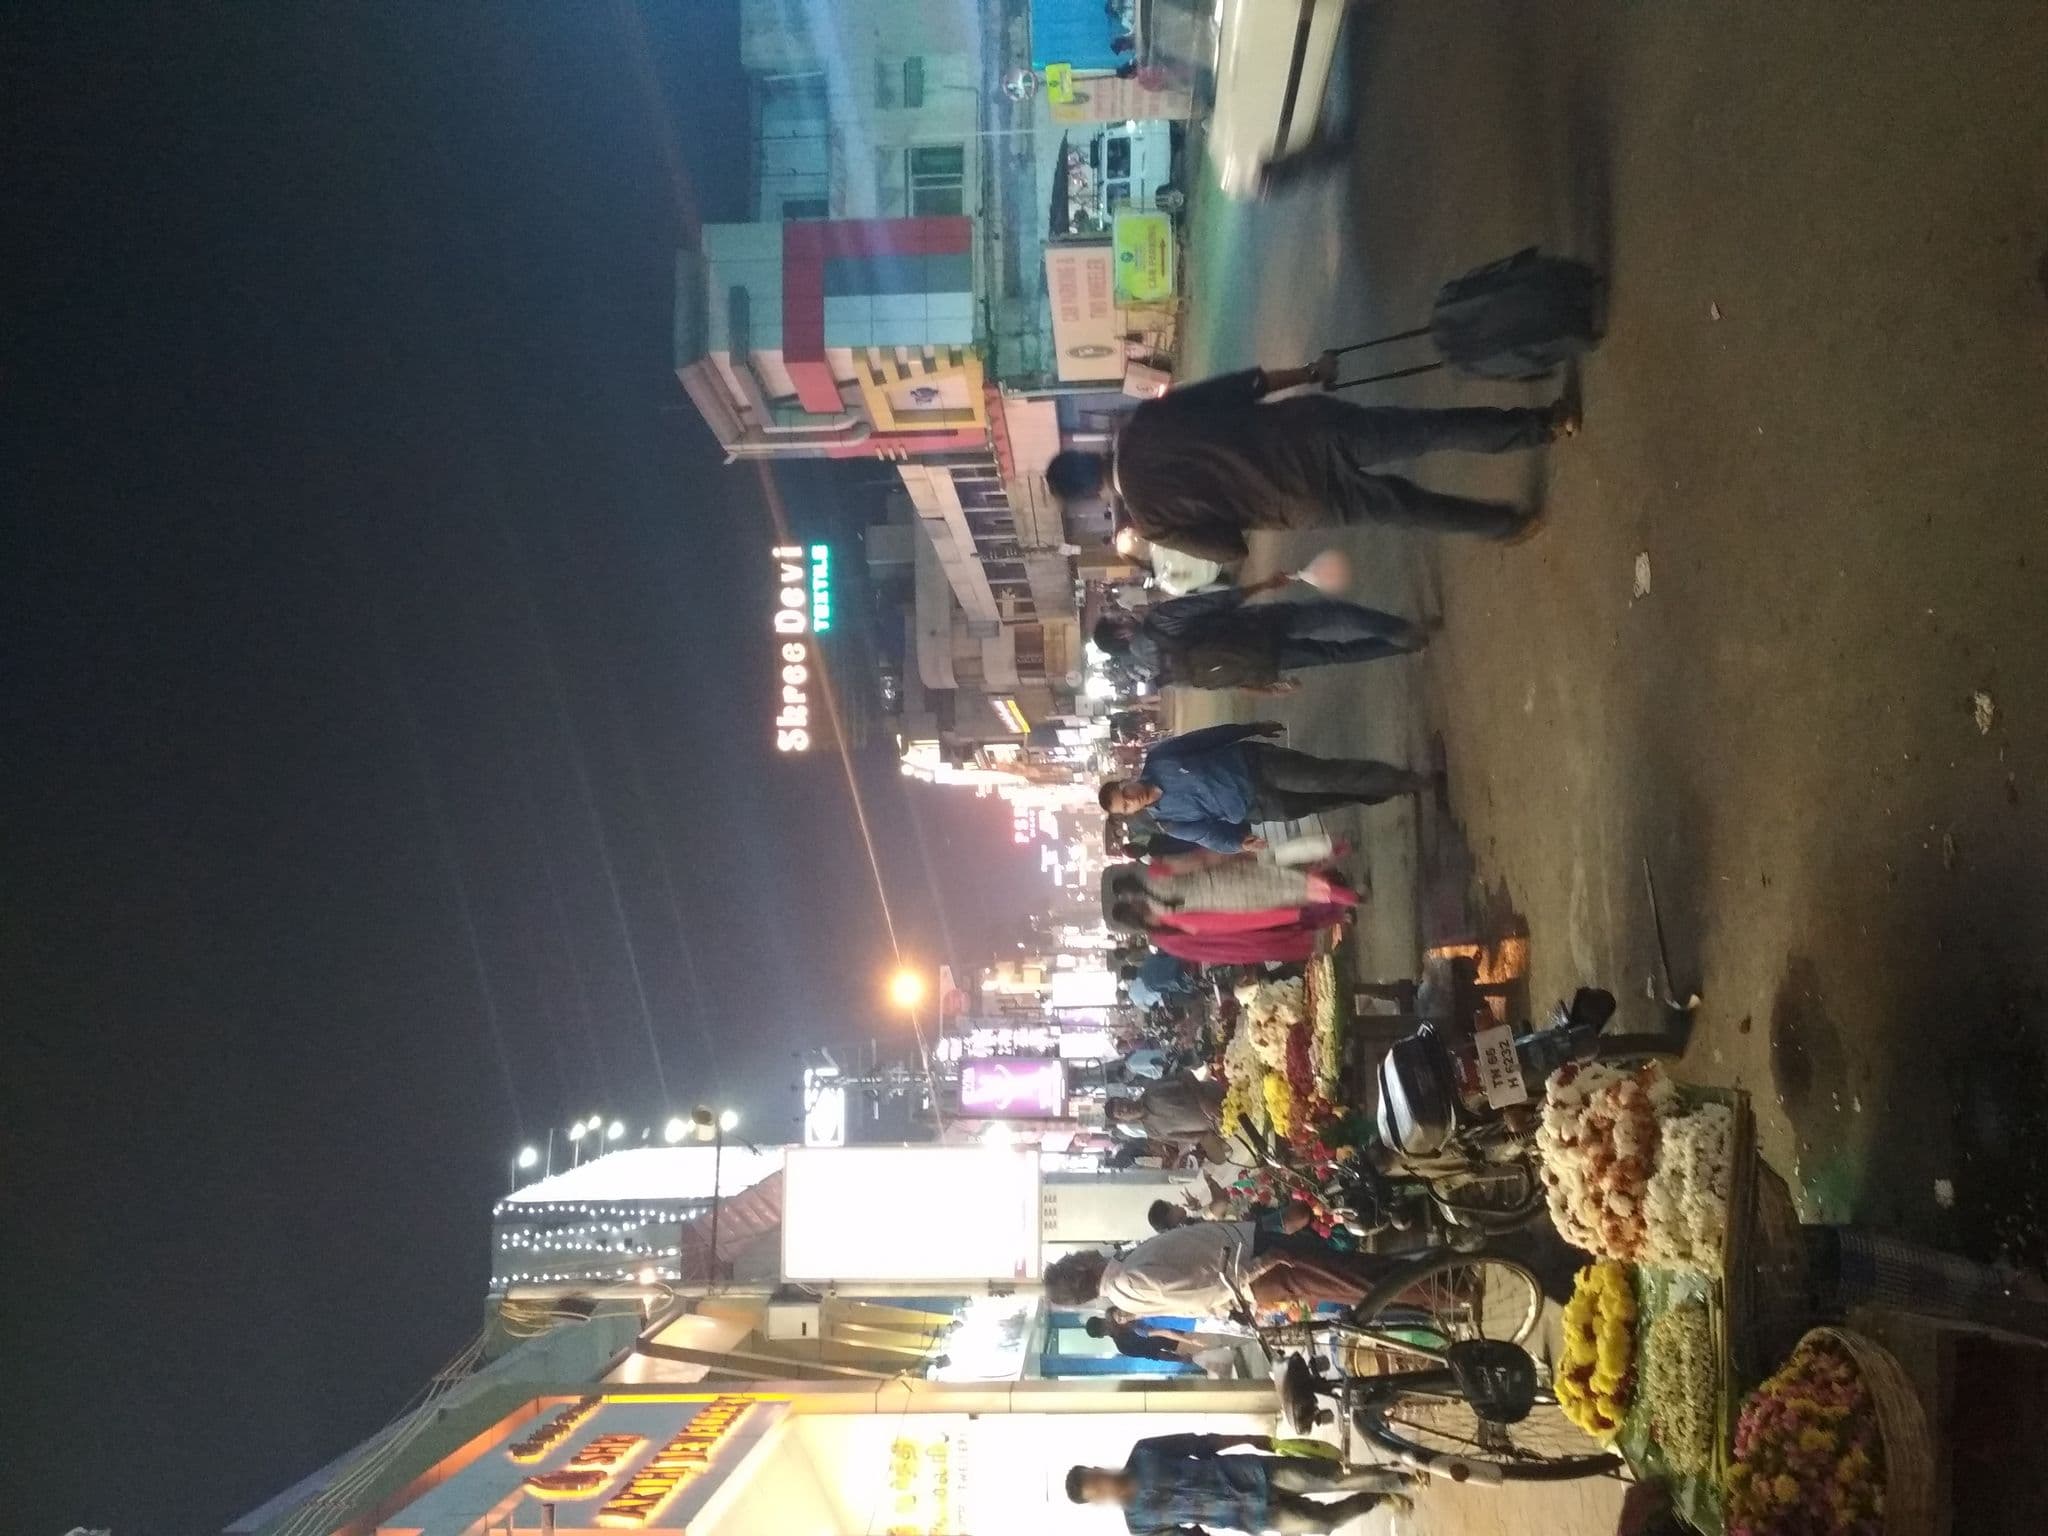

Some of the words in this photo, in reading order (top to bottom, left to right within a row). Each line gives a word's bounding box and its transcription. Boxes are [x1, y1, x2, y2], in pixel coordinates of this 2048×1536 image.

[1148, 269, 1156, 289] CAR
[772, 547, 806, 633] Devi
[812, 545, 830, 632] TEXTILE
[777, 643, 809, 752] Shree
[1491, 1069, 1503, 1088] TN
[1507, 1077, 1519, 1088] H
[599, 1466, 690, 1517] ARTHI
